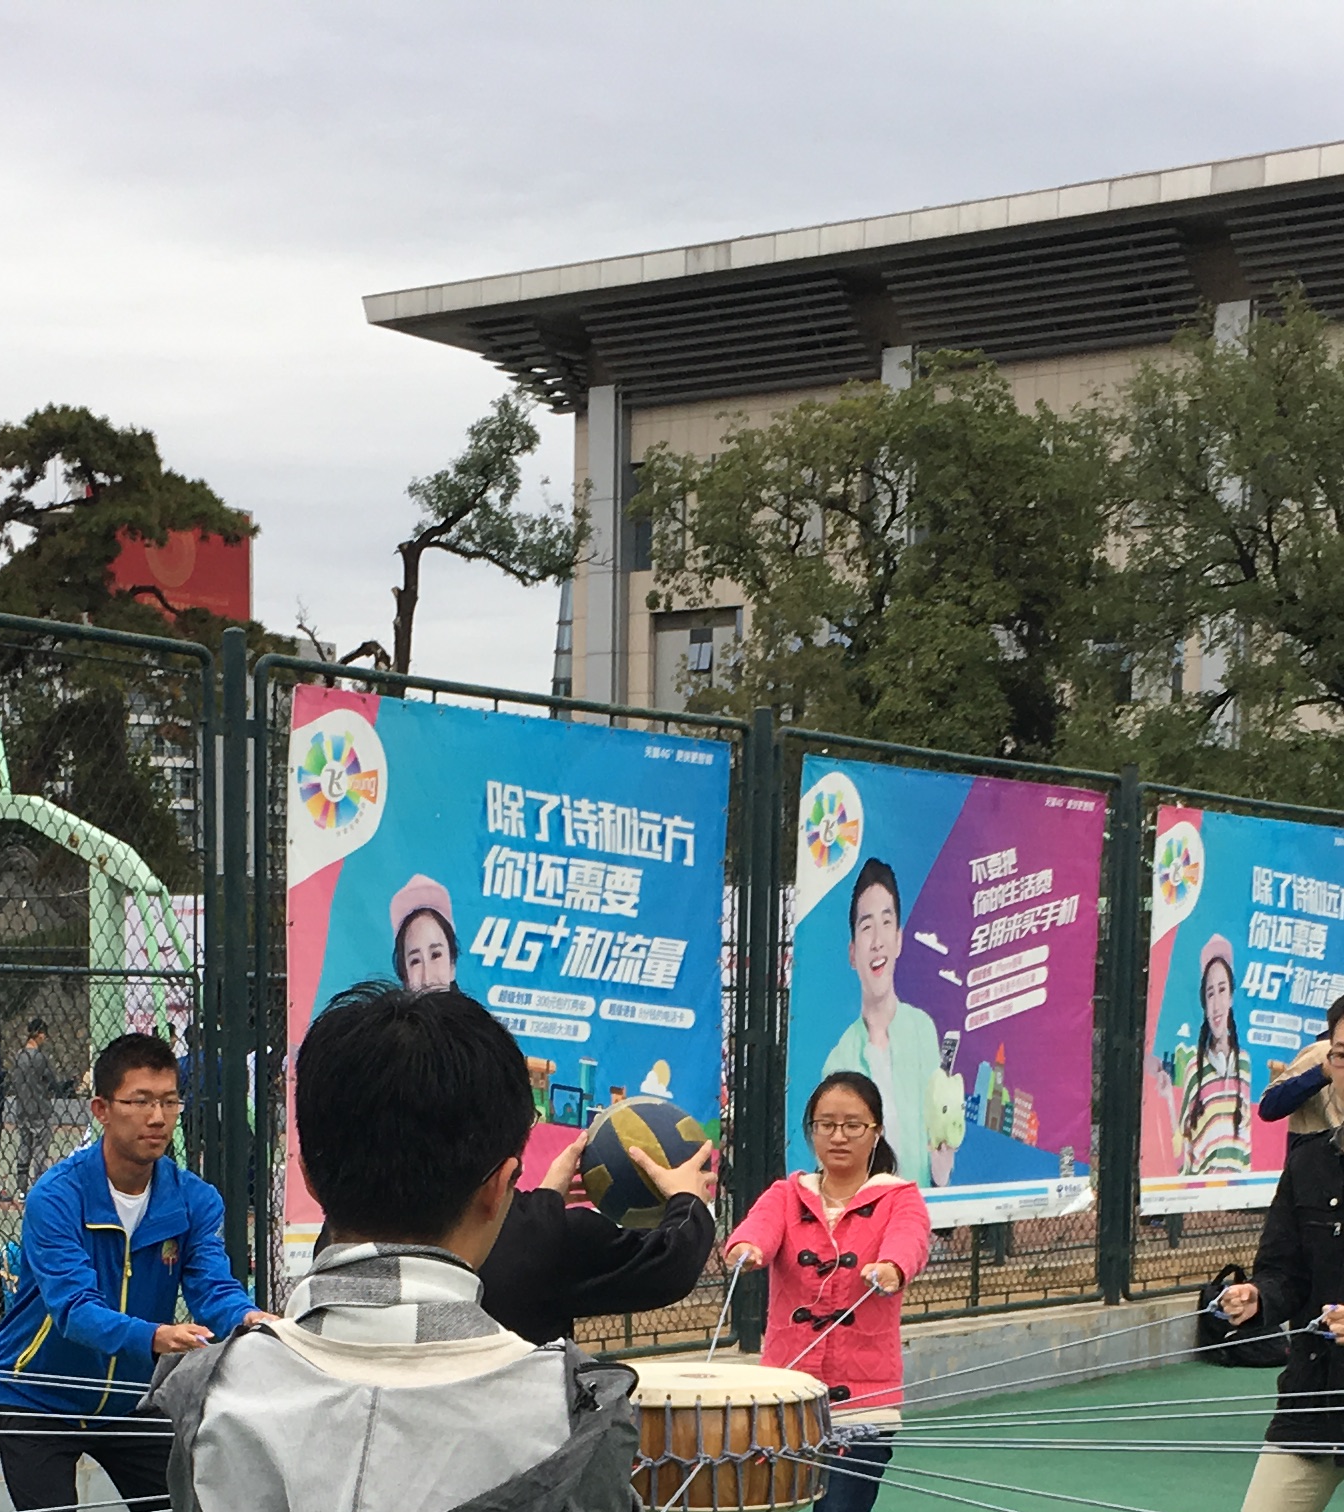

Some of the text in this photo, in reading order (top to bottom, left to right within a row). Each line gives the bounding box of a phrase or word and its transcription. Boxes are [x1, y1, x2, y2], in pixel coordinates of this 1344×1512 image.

[486, 780, 695, 867] 除了诗和远方
[483, 844, 644, 918] 你还需要
[968, 846, 1018, 885] 不要把
[972, 868, 1053, 918] 你的生活费
[469, 914, 689, 990] 4G+和流量
[968, 894, 1080, 956] 全用来买手机
[1247, 910, 1329, 961] 你还需要
